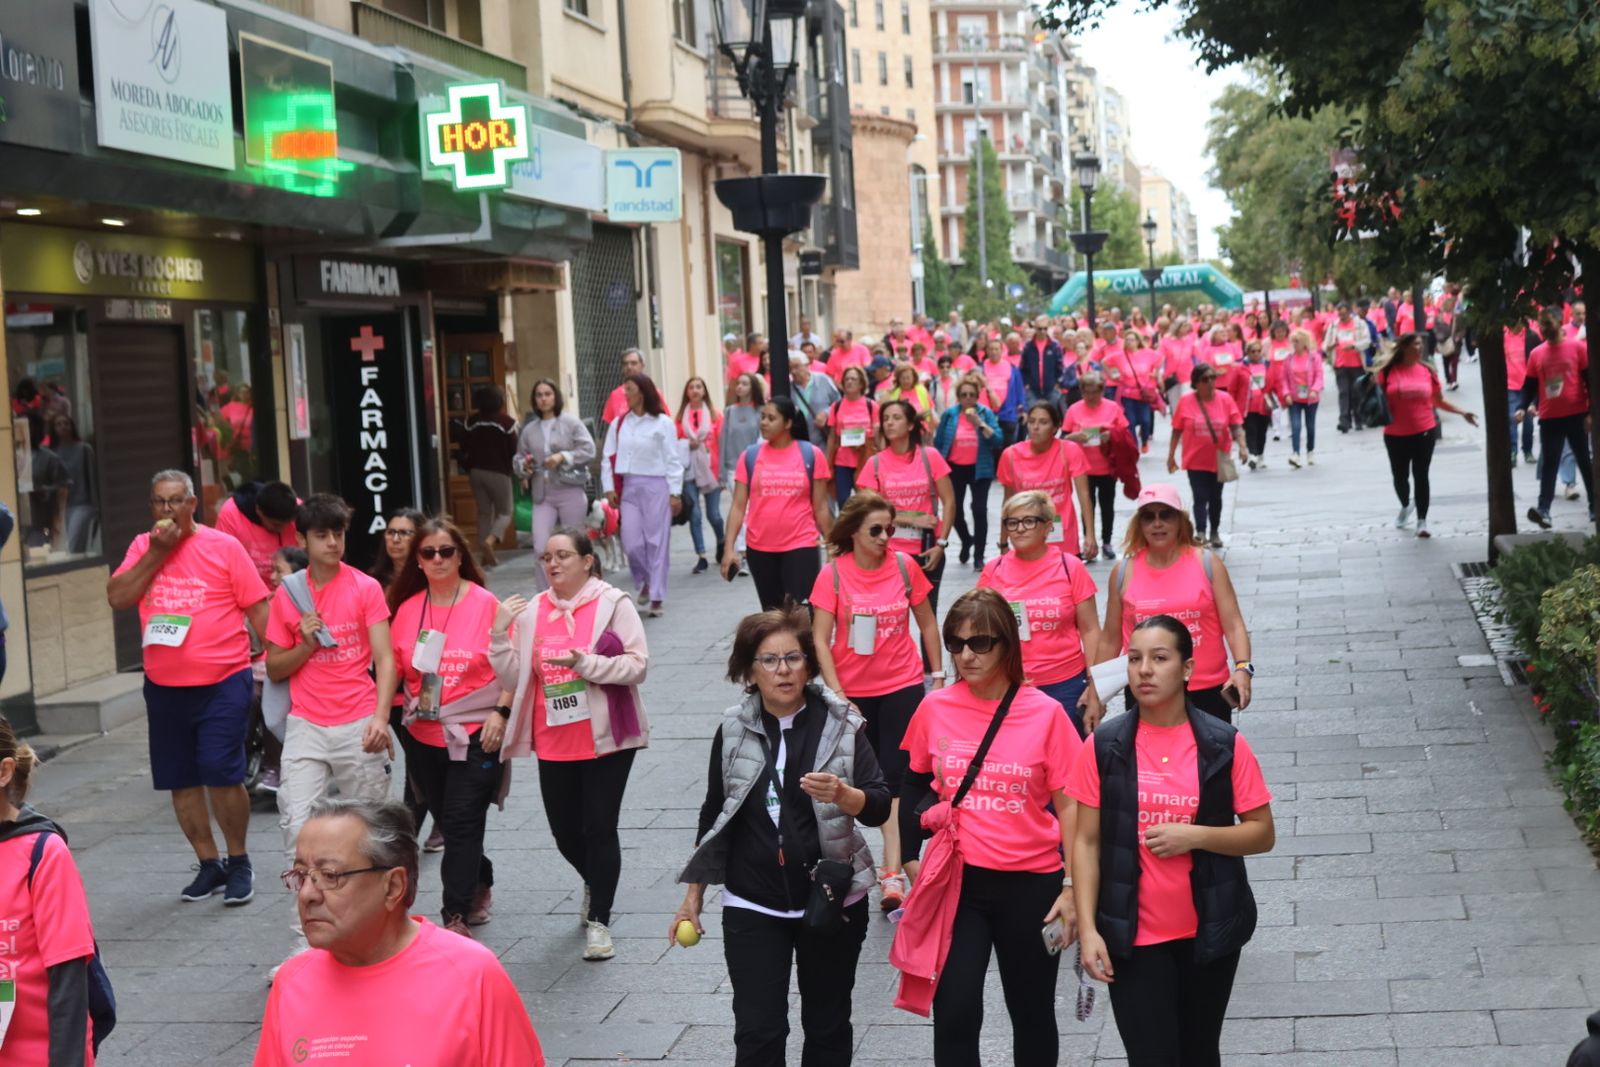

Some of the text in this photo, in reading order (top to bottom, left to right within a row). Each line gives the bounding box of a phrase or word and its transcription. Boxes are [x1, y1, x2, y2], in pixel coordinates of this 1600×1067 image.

[110, 76, 224, 124] MOREDA ABOGADOS
[120, 106, 220, 150] ASESORES FISCALES
[443, 120, 518, 153] HOR
[614, 197, 674, 212] randstad
[97, 251, 204, 282] YVES ROCHER
[320, 259, 400, 297] FARMACIA
[360, 366, 388, 535] FARMACIA
[945, 755, 1032, 778] En archa
[1152, 792, 1199, 808] marc
[1138, 809, 1192, 824] ontra
